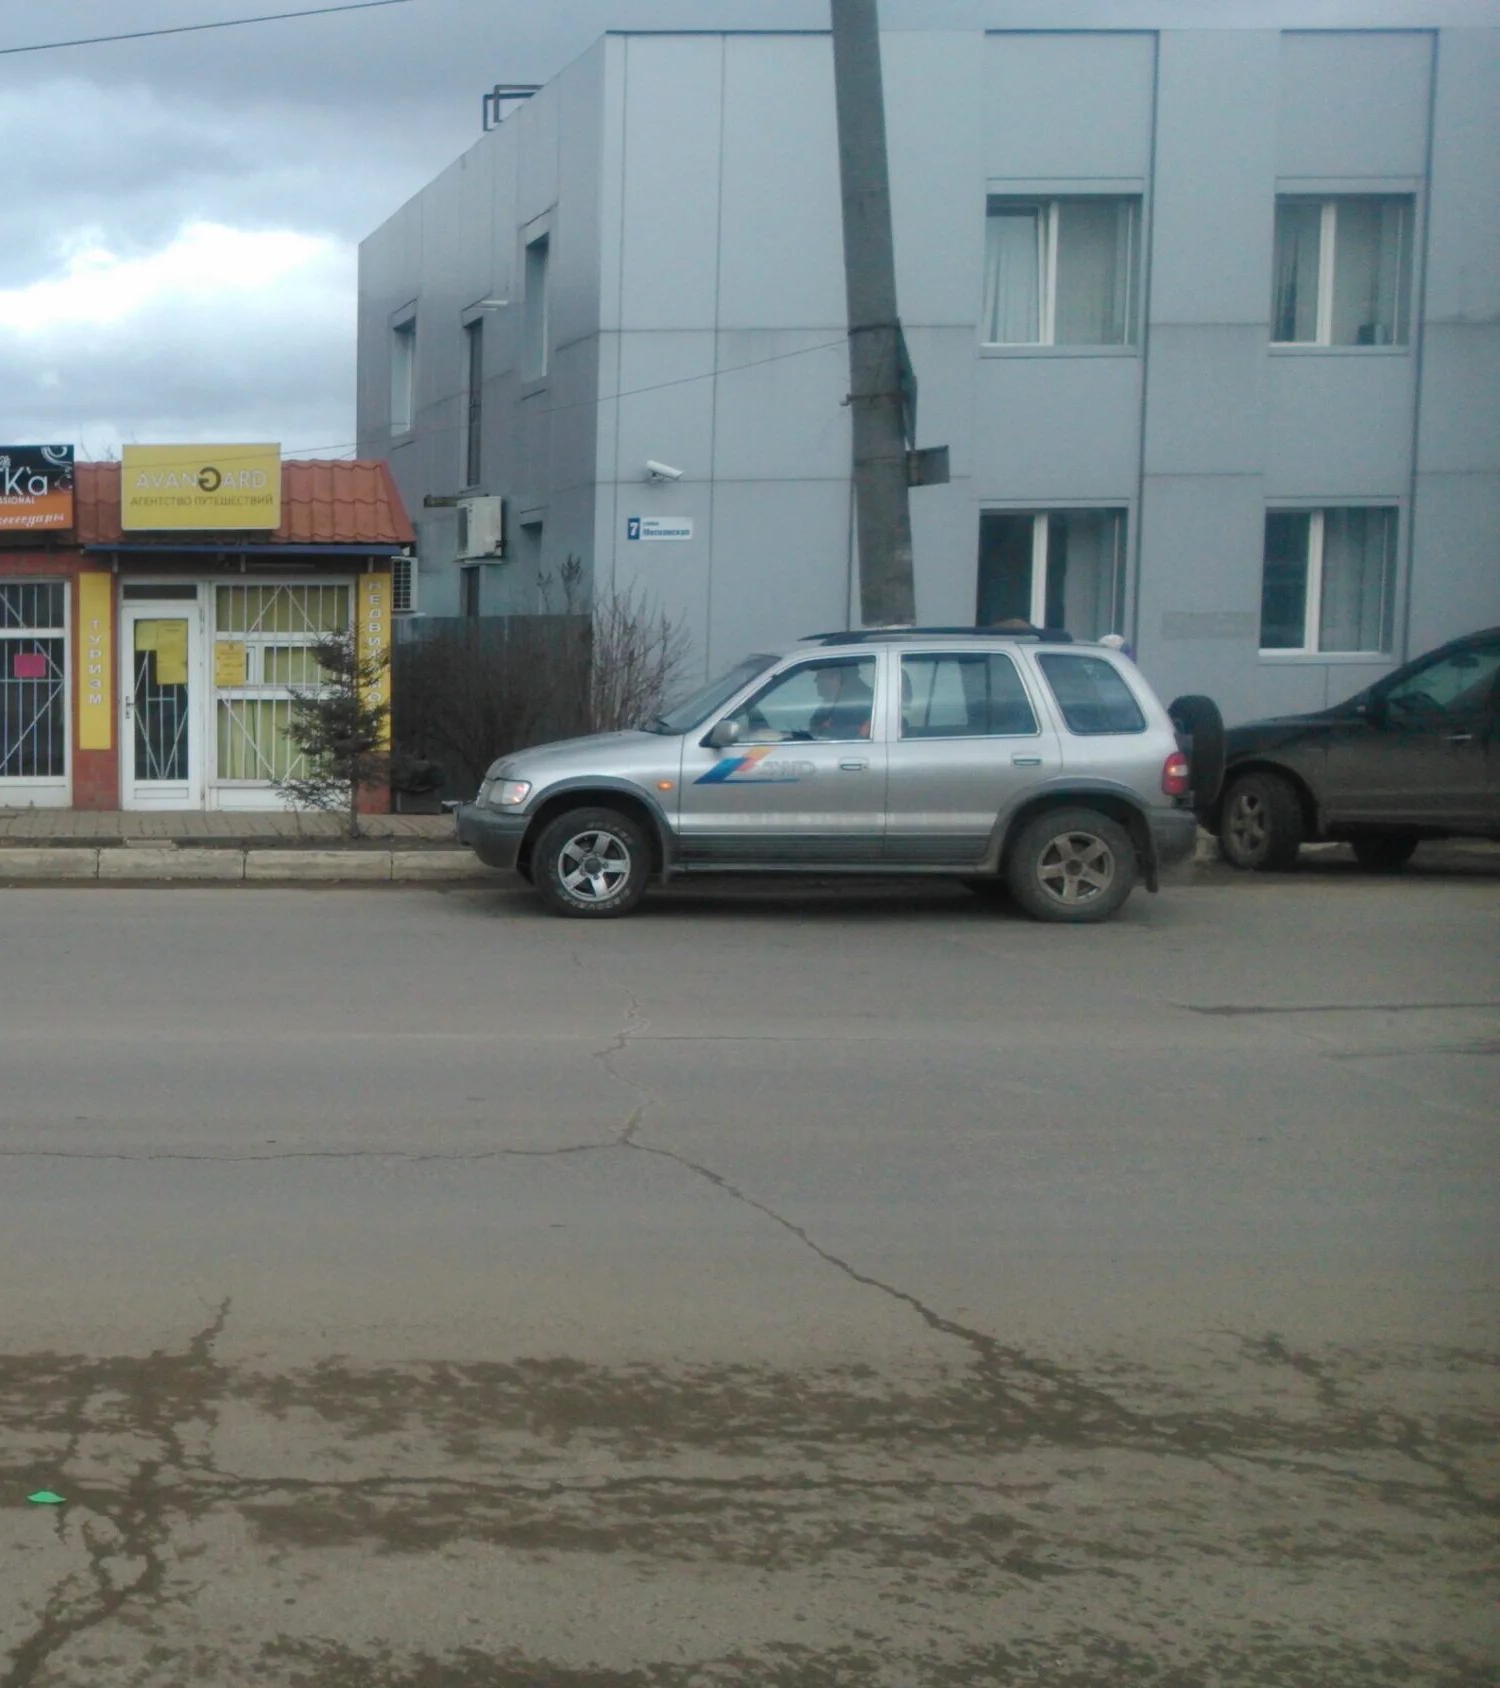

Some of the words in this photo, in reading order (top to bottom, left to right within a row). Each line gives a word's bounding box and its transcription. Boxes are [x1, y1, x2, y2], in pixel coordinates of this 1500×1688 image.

[130, 495, 193, 506] АГЕНТСТВО
[195, 493, 274, 506] ПУТЕШЕСТВИЙ
[629, 521, 639, 536] 7
